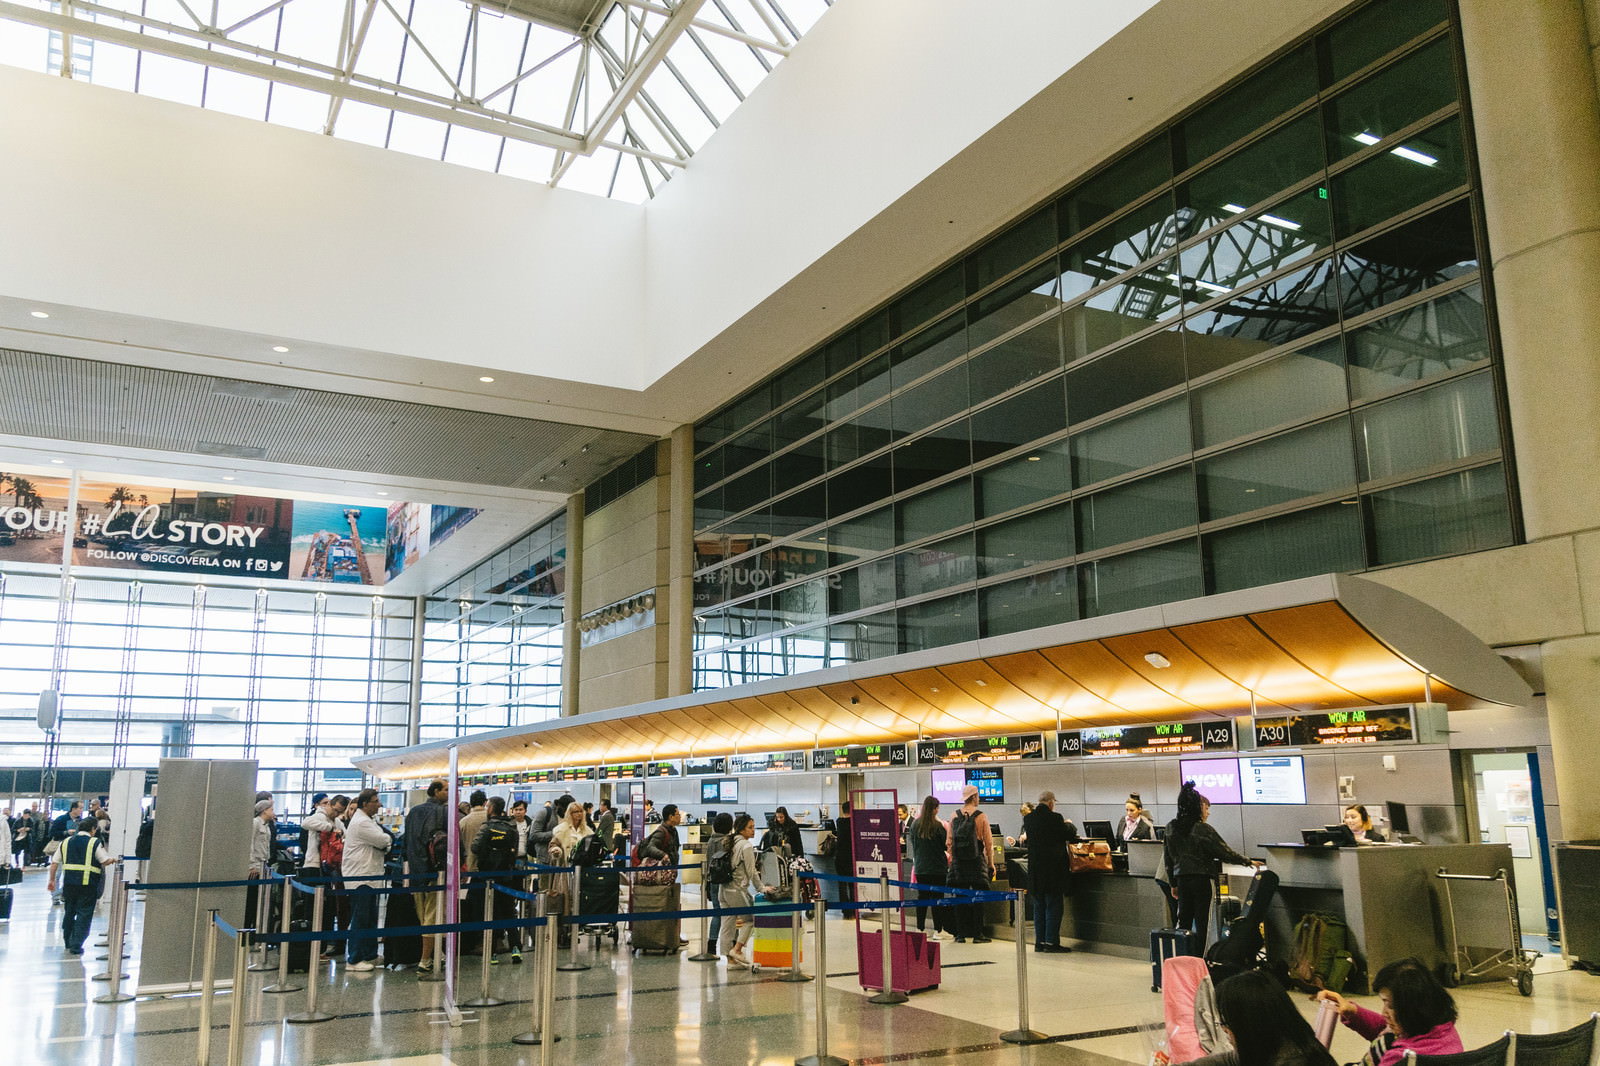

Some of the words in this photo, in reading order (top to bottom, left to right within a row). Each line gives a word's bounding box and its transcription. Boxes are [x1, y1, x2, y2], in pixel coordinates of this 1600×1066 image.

[168, 520, 265, 547] STORY
[87, 549, 138, 561] FOLLOW
[140, 552, 220, 567] @DISCOVERLA
[223, 559, 241, 568] ON
[1328, 712, 1348, 723] WOW
[1352, 710, 1367, 722] AIR
[1155, 724, 1170, 735] WOW
[1173, 723, 1184, 734] AIR
[1259, 726, 1284, 741] A30
[1206, 729, 1229, 743] A29
[1023, 741, 1039, 753] A27
[1062, 738, 1080, 751] A28
[891, 750, 904, 760] A25
[920, 748, 934, 759] A26
[814, 755, 825, 765] A24
[935, 780, 963, 791] WOW
